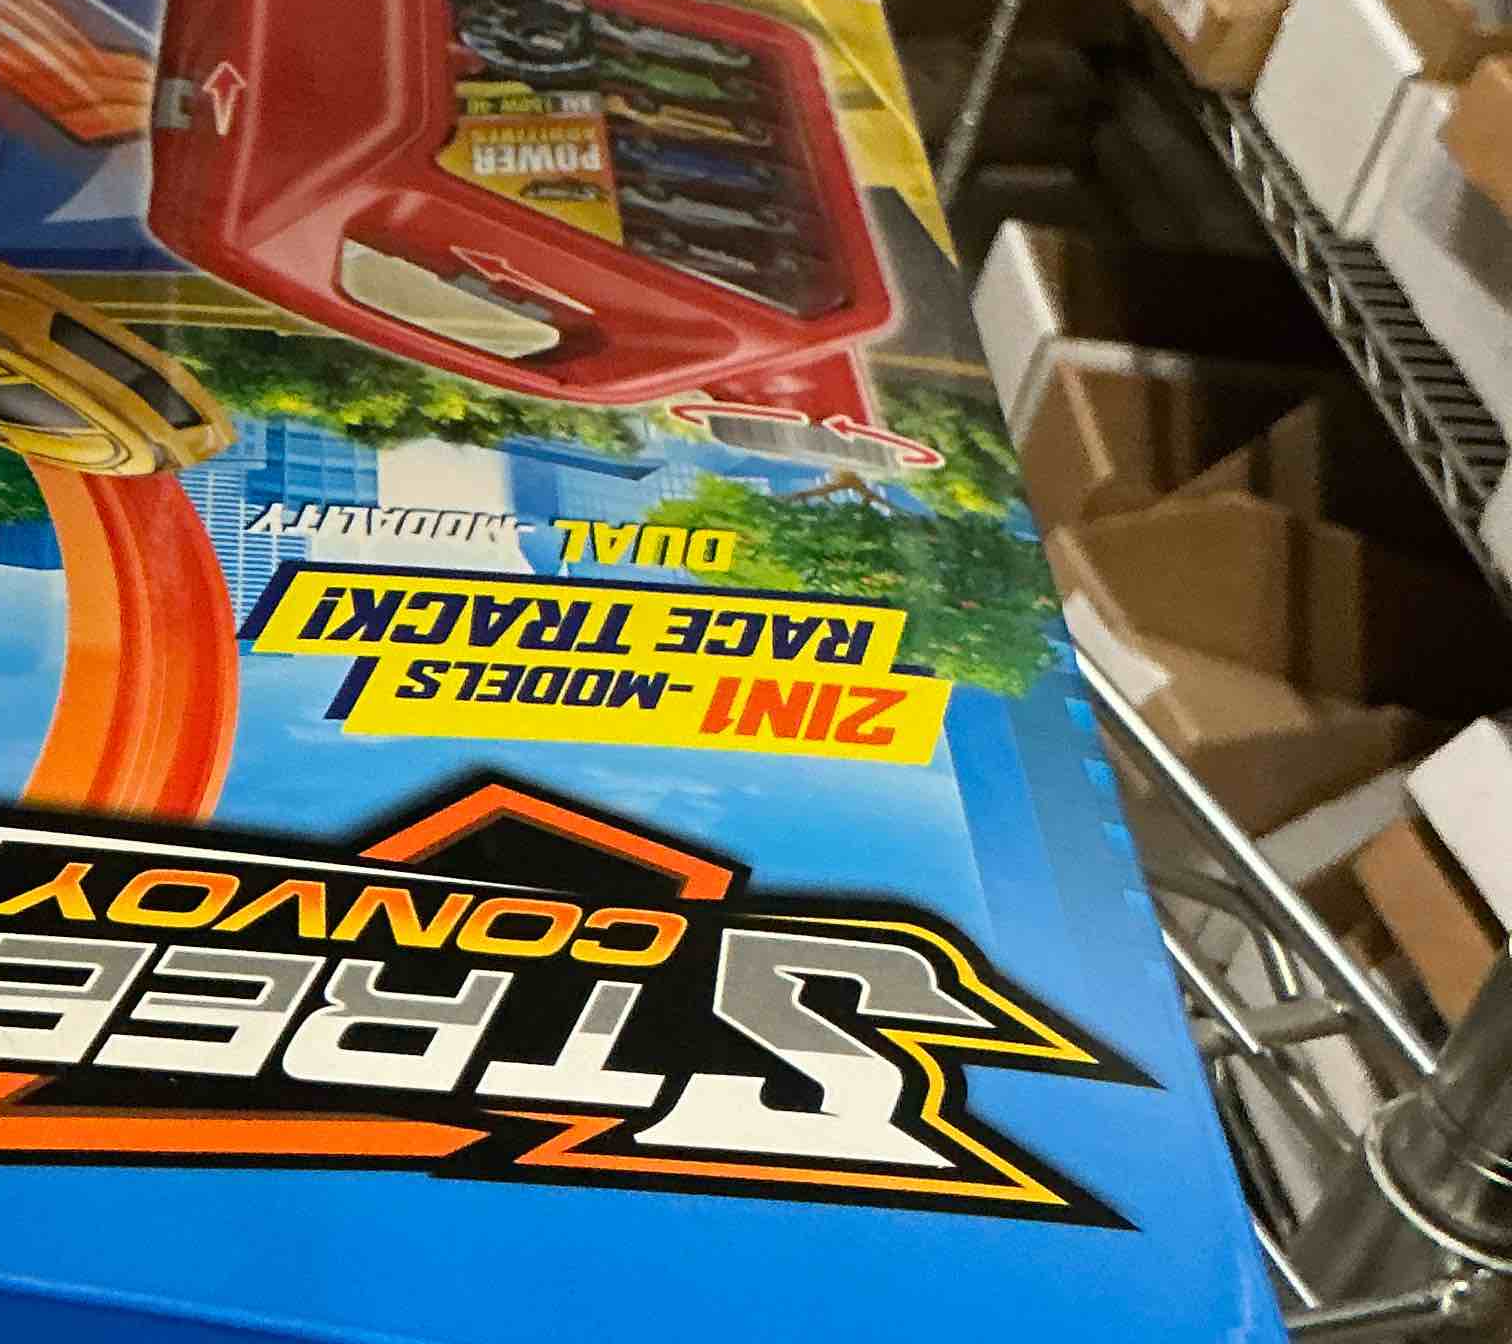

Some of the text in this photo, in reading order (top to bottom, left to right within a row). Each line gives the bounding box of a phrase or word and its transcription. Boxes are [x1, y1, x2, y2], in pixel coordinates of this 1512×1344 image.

[471, 143, 601, 177] POWER
[550, 517, 737, 572] DUAL
[296, 586, 875, 666] RACE TRACK!
[700, 676, 907, 746] 2IN1
